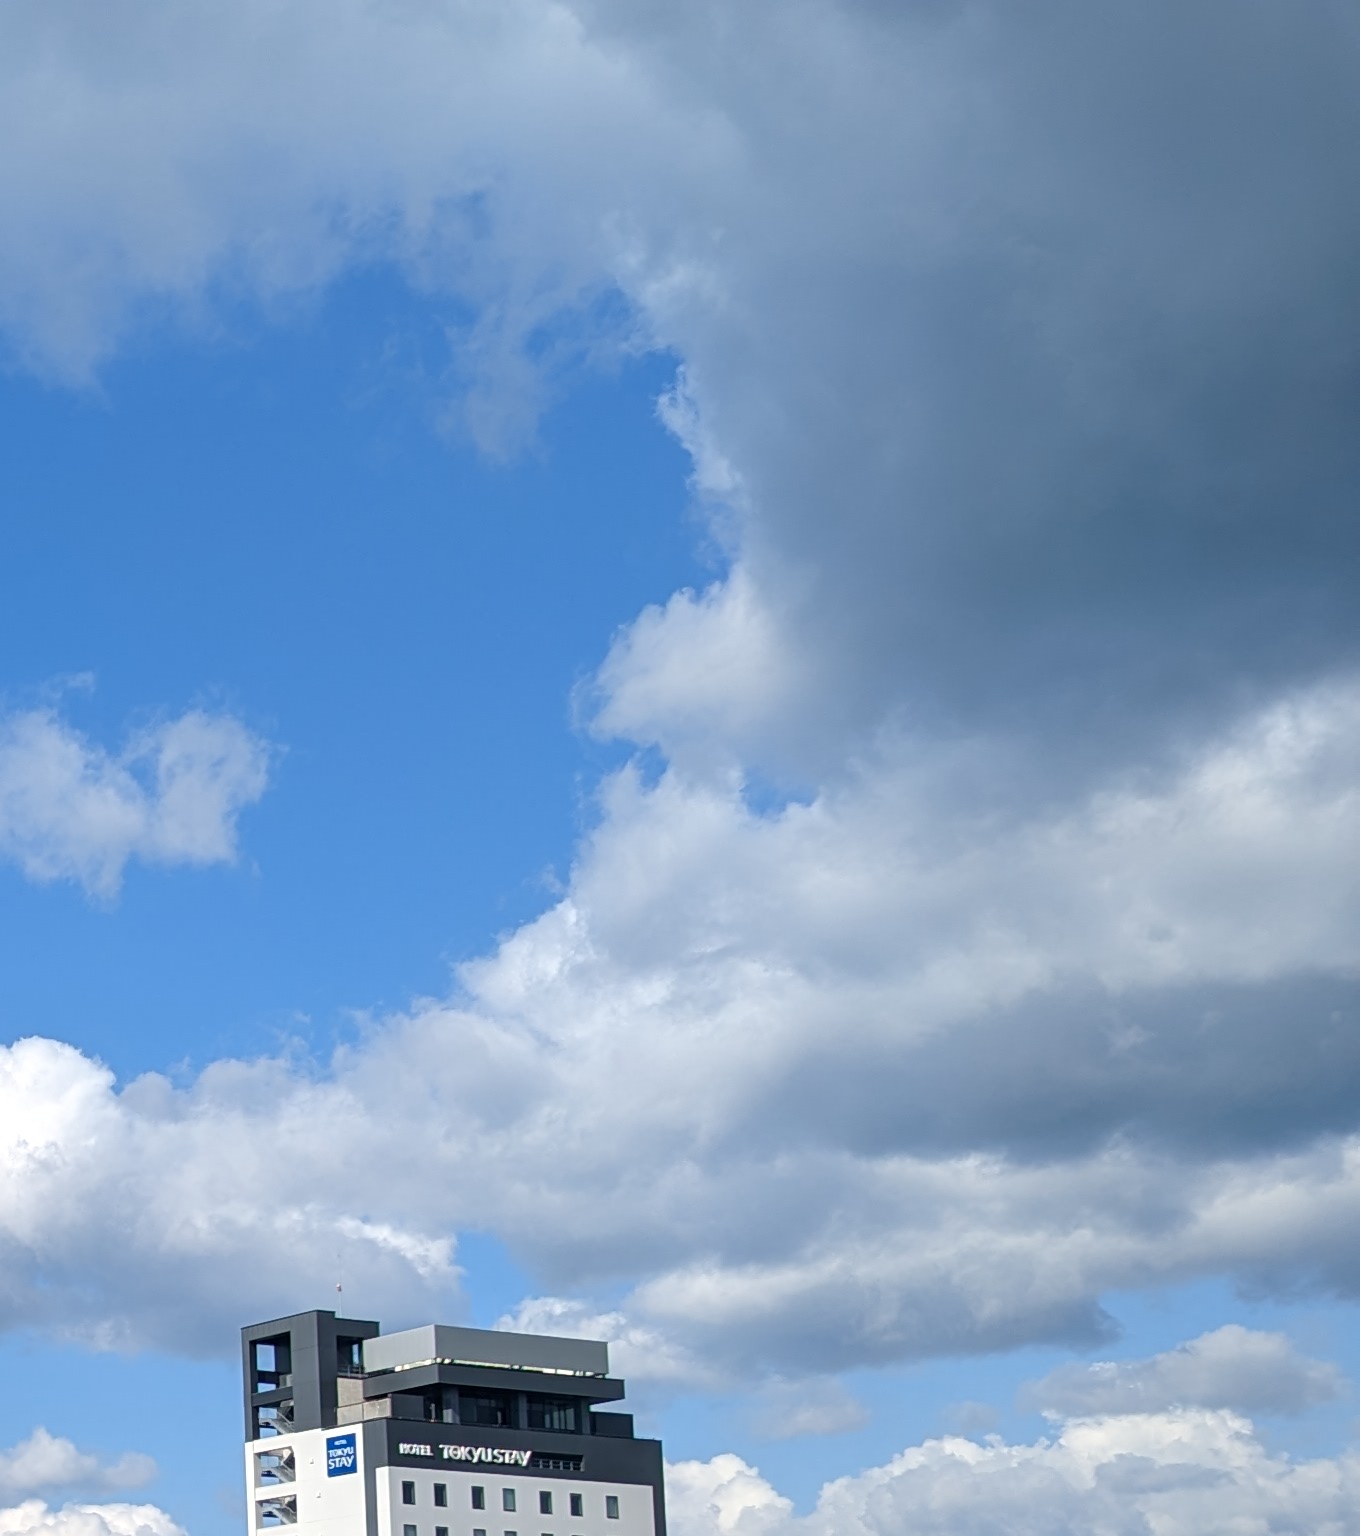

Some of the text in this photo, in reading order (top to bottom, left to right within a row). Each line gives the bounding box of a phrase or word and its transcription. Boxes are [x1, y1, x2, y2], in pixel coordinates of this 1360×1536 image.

[328, 1446, 354, 1457] TOKYU
[399, 1443, 434, 1456] HOTEL
[328, 1455, 354, 1470] STAY
